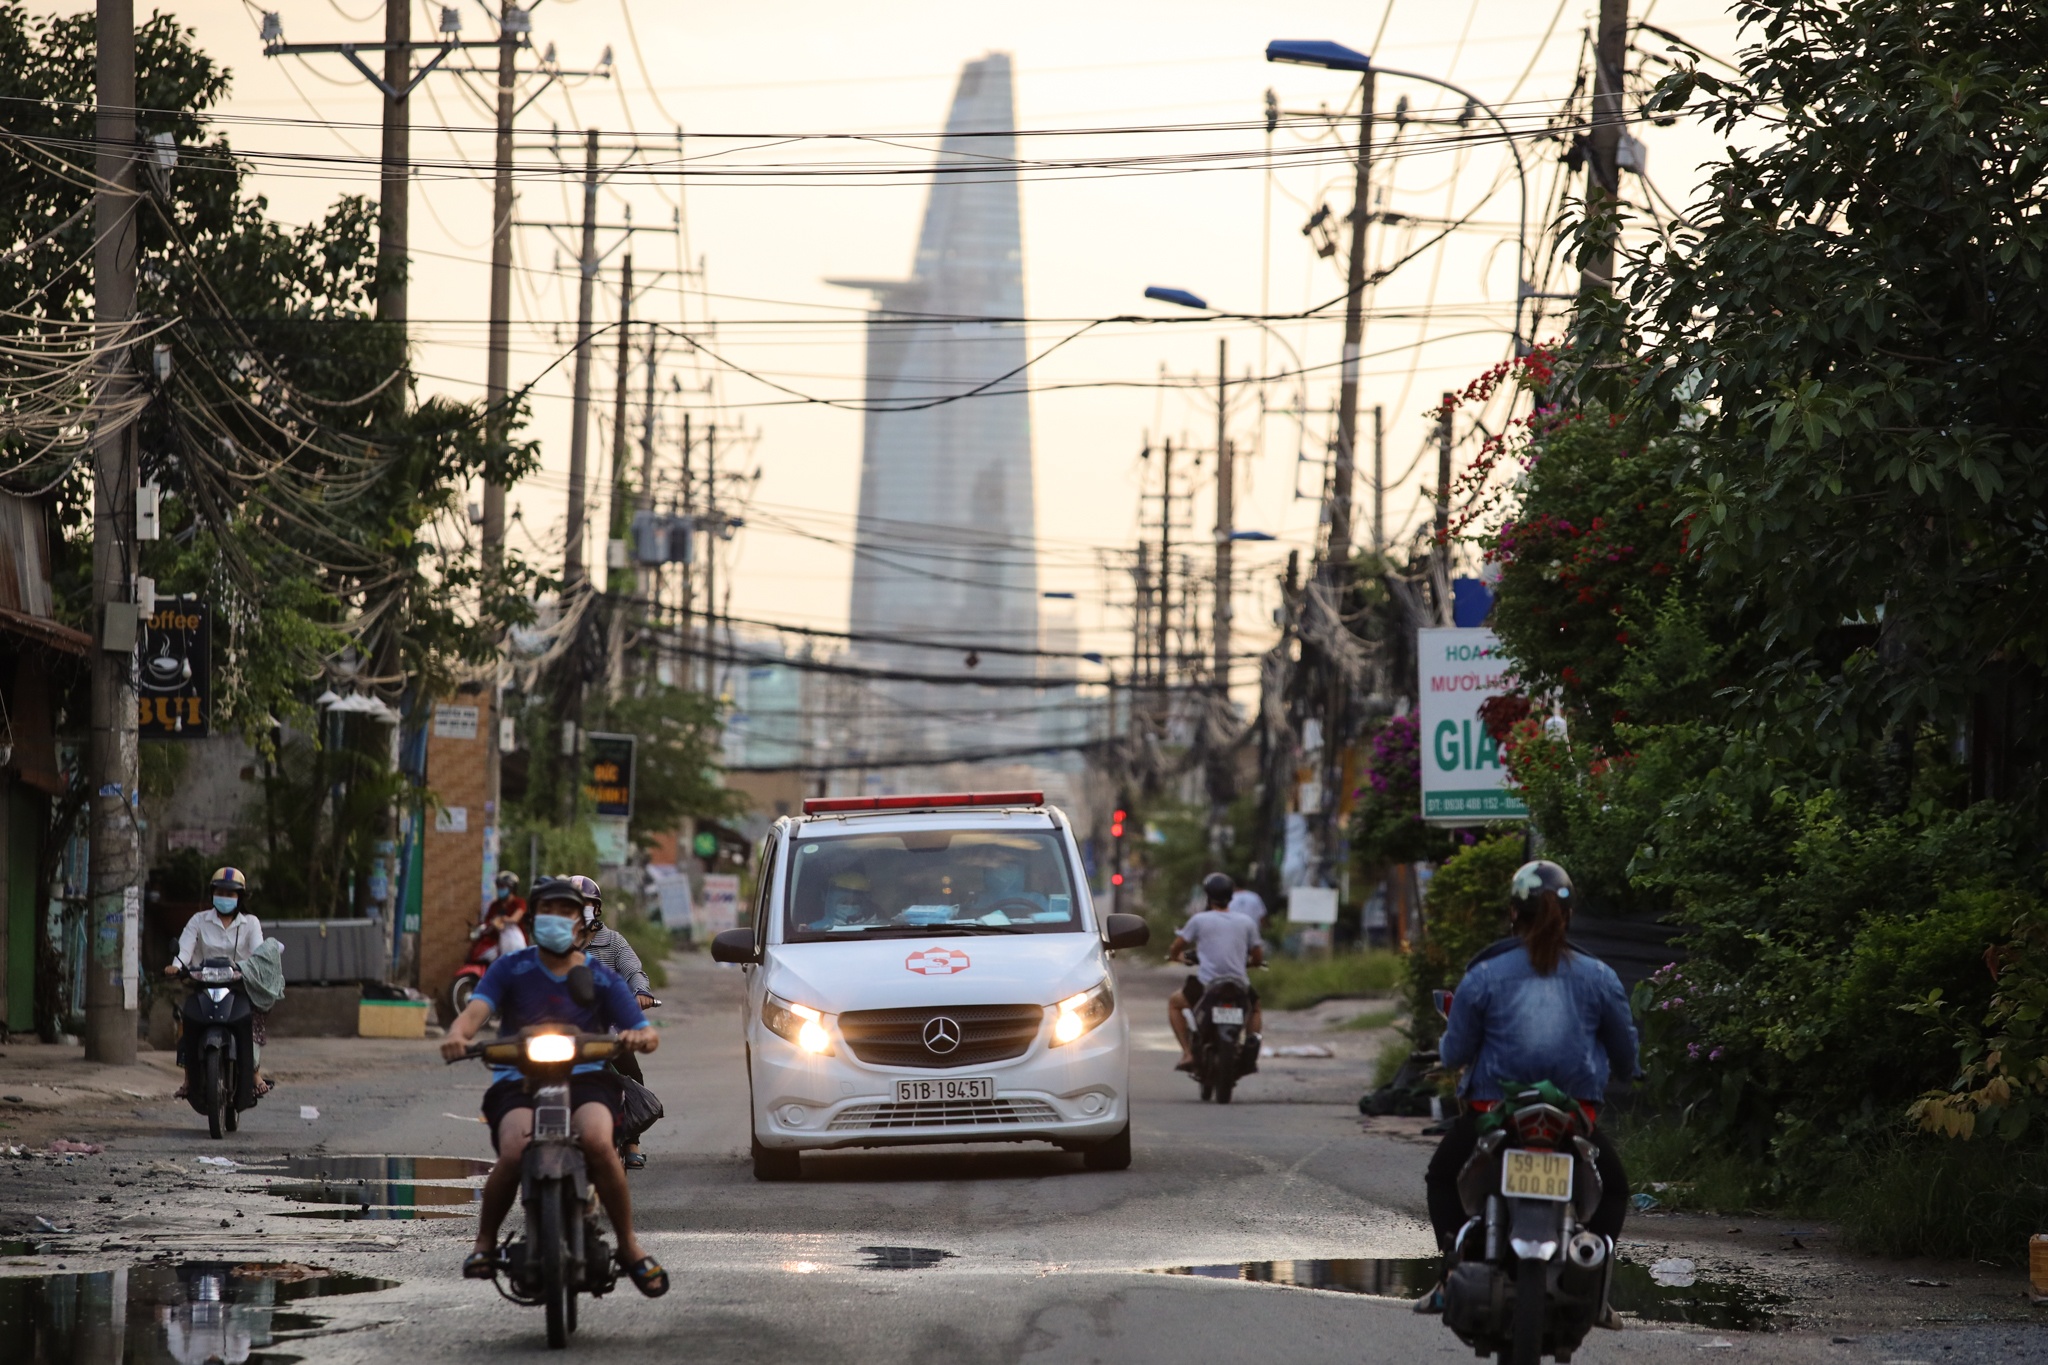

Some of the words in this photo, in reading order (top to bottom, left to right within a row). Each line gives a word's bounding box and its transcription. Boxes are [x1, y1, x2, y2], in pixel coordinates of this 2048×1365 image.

[148, 611, 199, 630] offee
[1445, 645, 1483, 661] HOA
[901, 1080, 987, 1100] 51B-194.51
